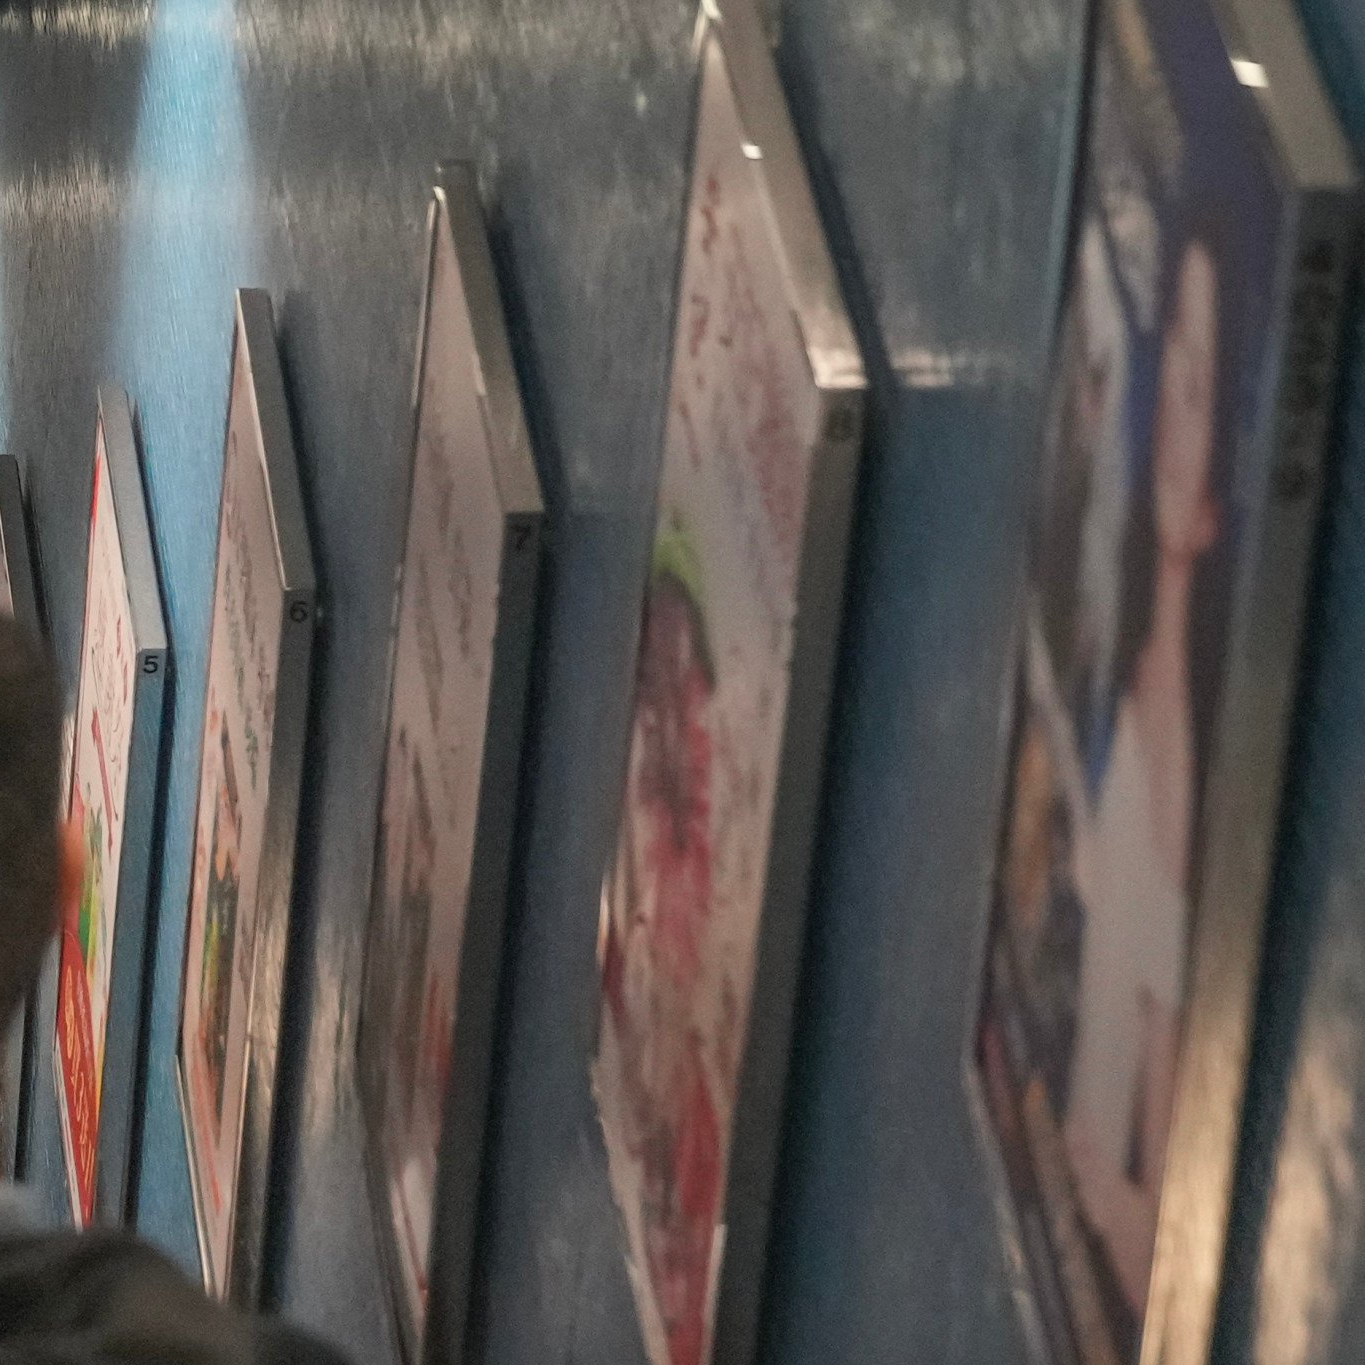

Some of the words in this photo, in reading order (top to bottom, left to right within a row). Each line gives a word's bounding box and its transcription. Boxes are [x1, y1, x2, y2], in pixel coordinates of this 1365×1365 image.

[511, 523, 532, 551] 7
[290, 601, 308, 623] 6
[143, 655, 159, 674] 5
